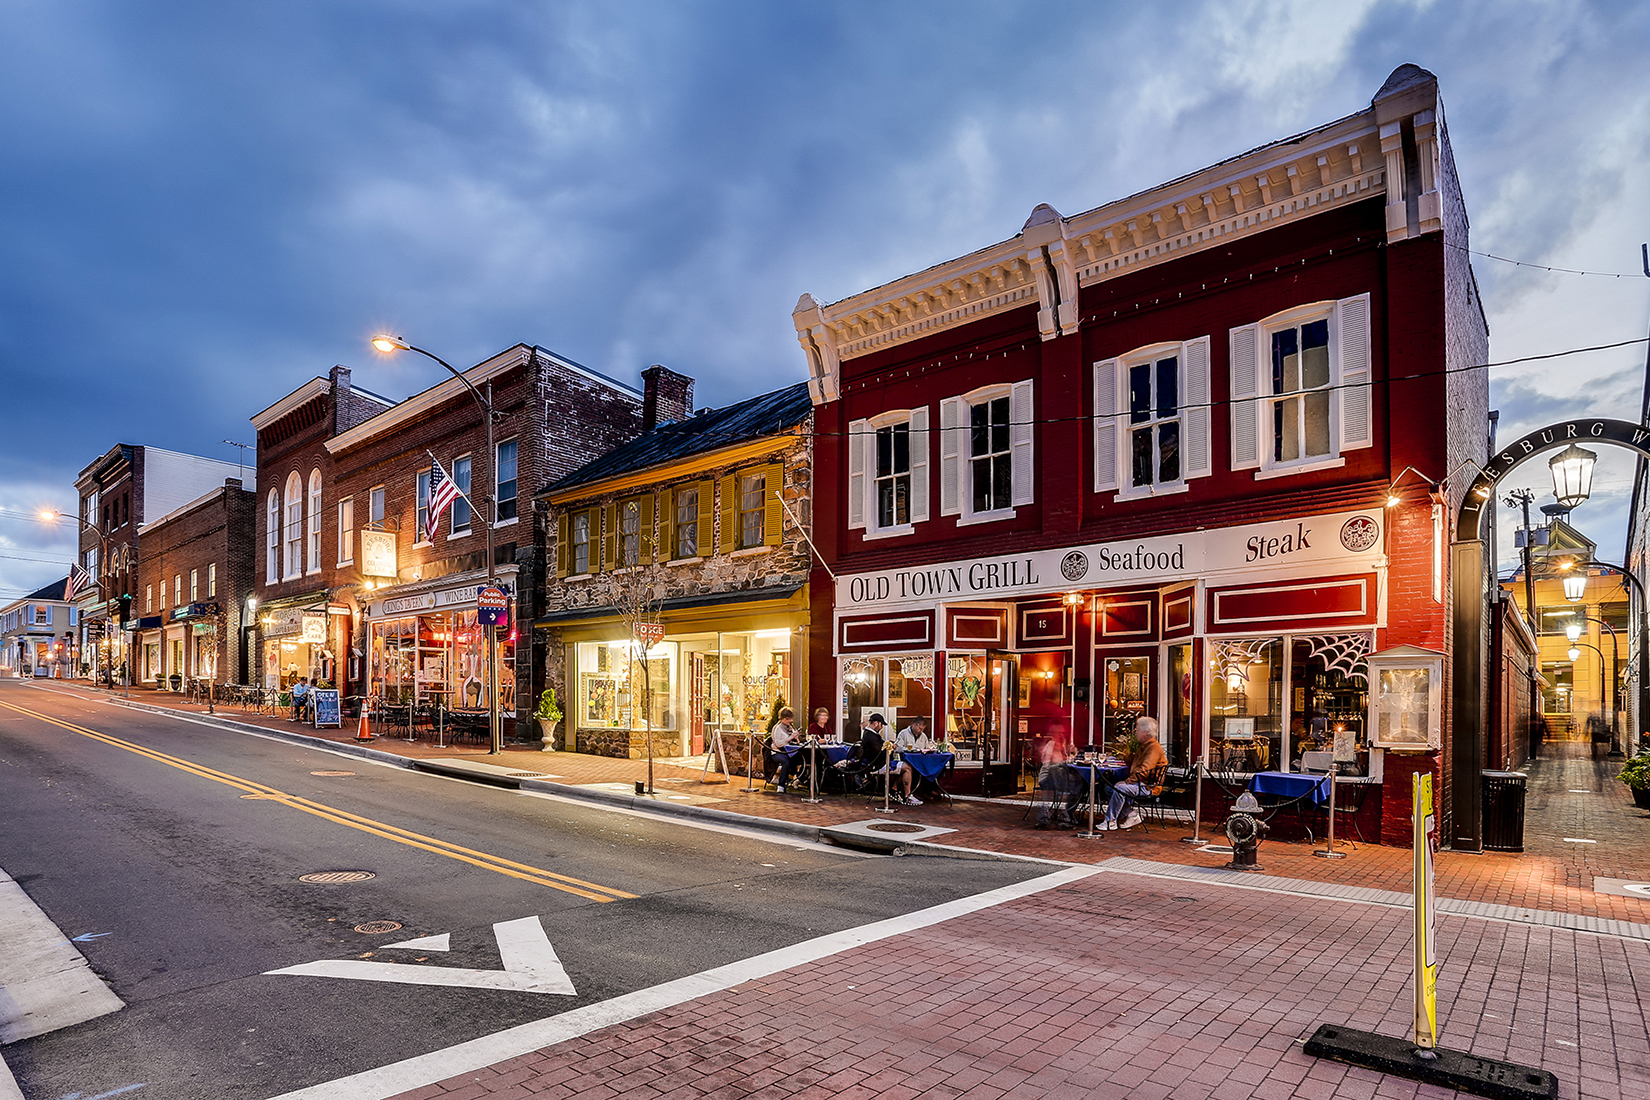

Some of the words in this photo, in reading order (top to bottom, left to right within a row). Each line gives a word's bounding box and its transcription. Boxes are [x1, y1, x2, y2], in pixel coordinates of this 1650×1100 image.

[1464, 422, 1604, 512] LESBURG
[1246, 523, 1311, 563] Steak
[1099, 543, 1185, 571] Seafood
[850, 576, 890, 602] OLD
[896, 567, 962, 598] TOWN
[968, 559, 1040, 591] GRILL
[445, 589, 463, 603] WINE
[464, 587, 478, 600] BAR
[479, 596, 506, 606] Parking
[1038, 620, 1047, 629] 15
[742, 675, 767, 684] ROUGE
[955, 750, 971, 761] Open
